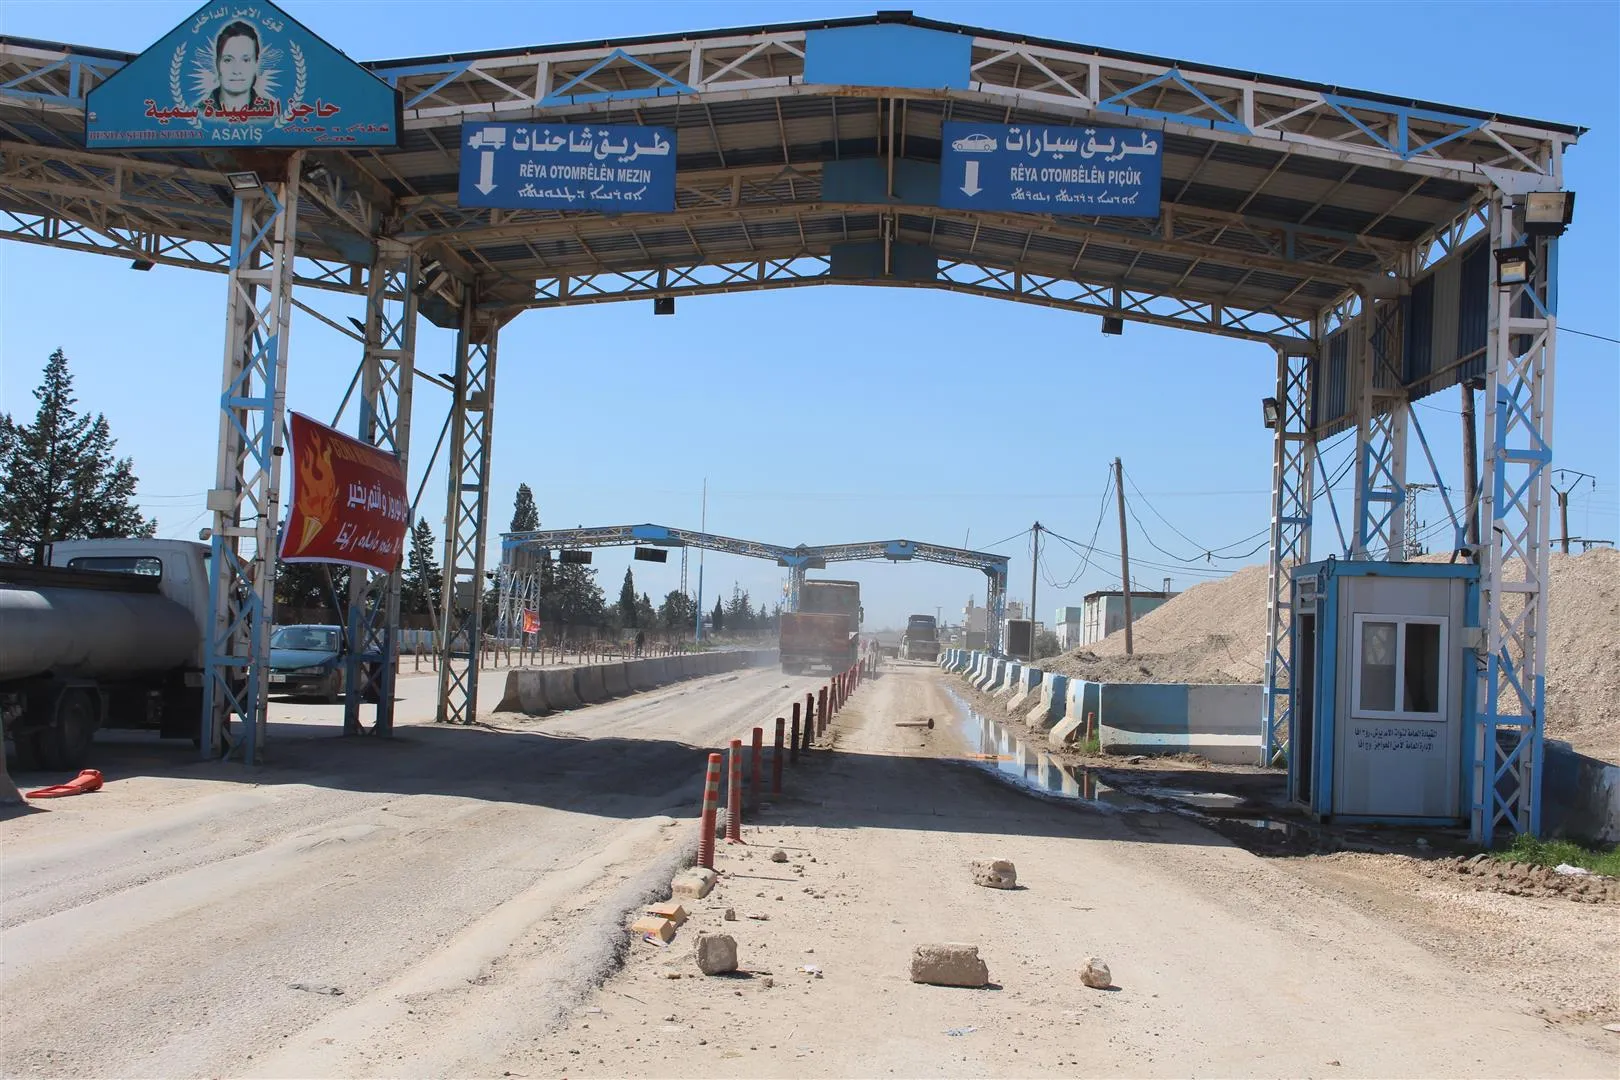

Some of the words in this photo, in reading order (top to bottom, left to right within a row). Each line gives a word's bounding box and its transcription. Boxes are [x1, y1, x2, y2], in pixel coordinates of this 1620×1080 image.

[144, 98, 200, 125] سمية
[204, 98, 281, 124] الشهيدة
[285, 98, 341, 123] حاجز
[512, 127, 593, 153] شاحنات
[594, 127, 670, 163] طريق
[1005, 127, 1078, 160] سيارات
[1080, 128, 1158, 162] طريق
[519, 160, 547, 179] RÊYA
[617, 168, 651, 184] MEZIN
[1010, 163, 1038, 182] RÊYA
[1040, 164, 1105, 185] OTOMBÊLÊN
[1108, 166, 1142, 187] PIÇÛK
